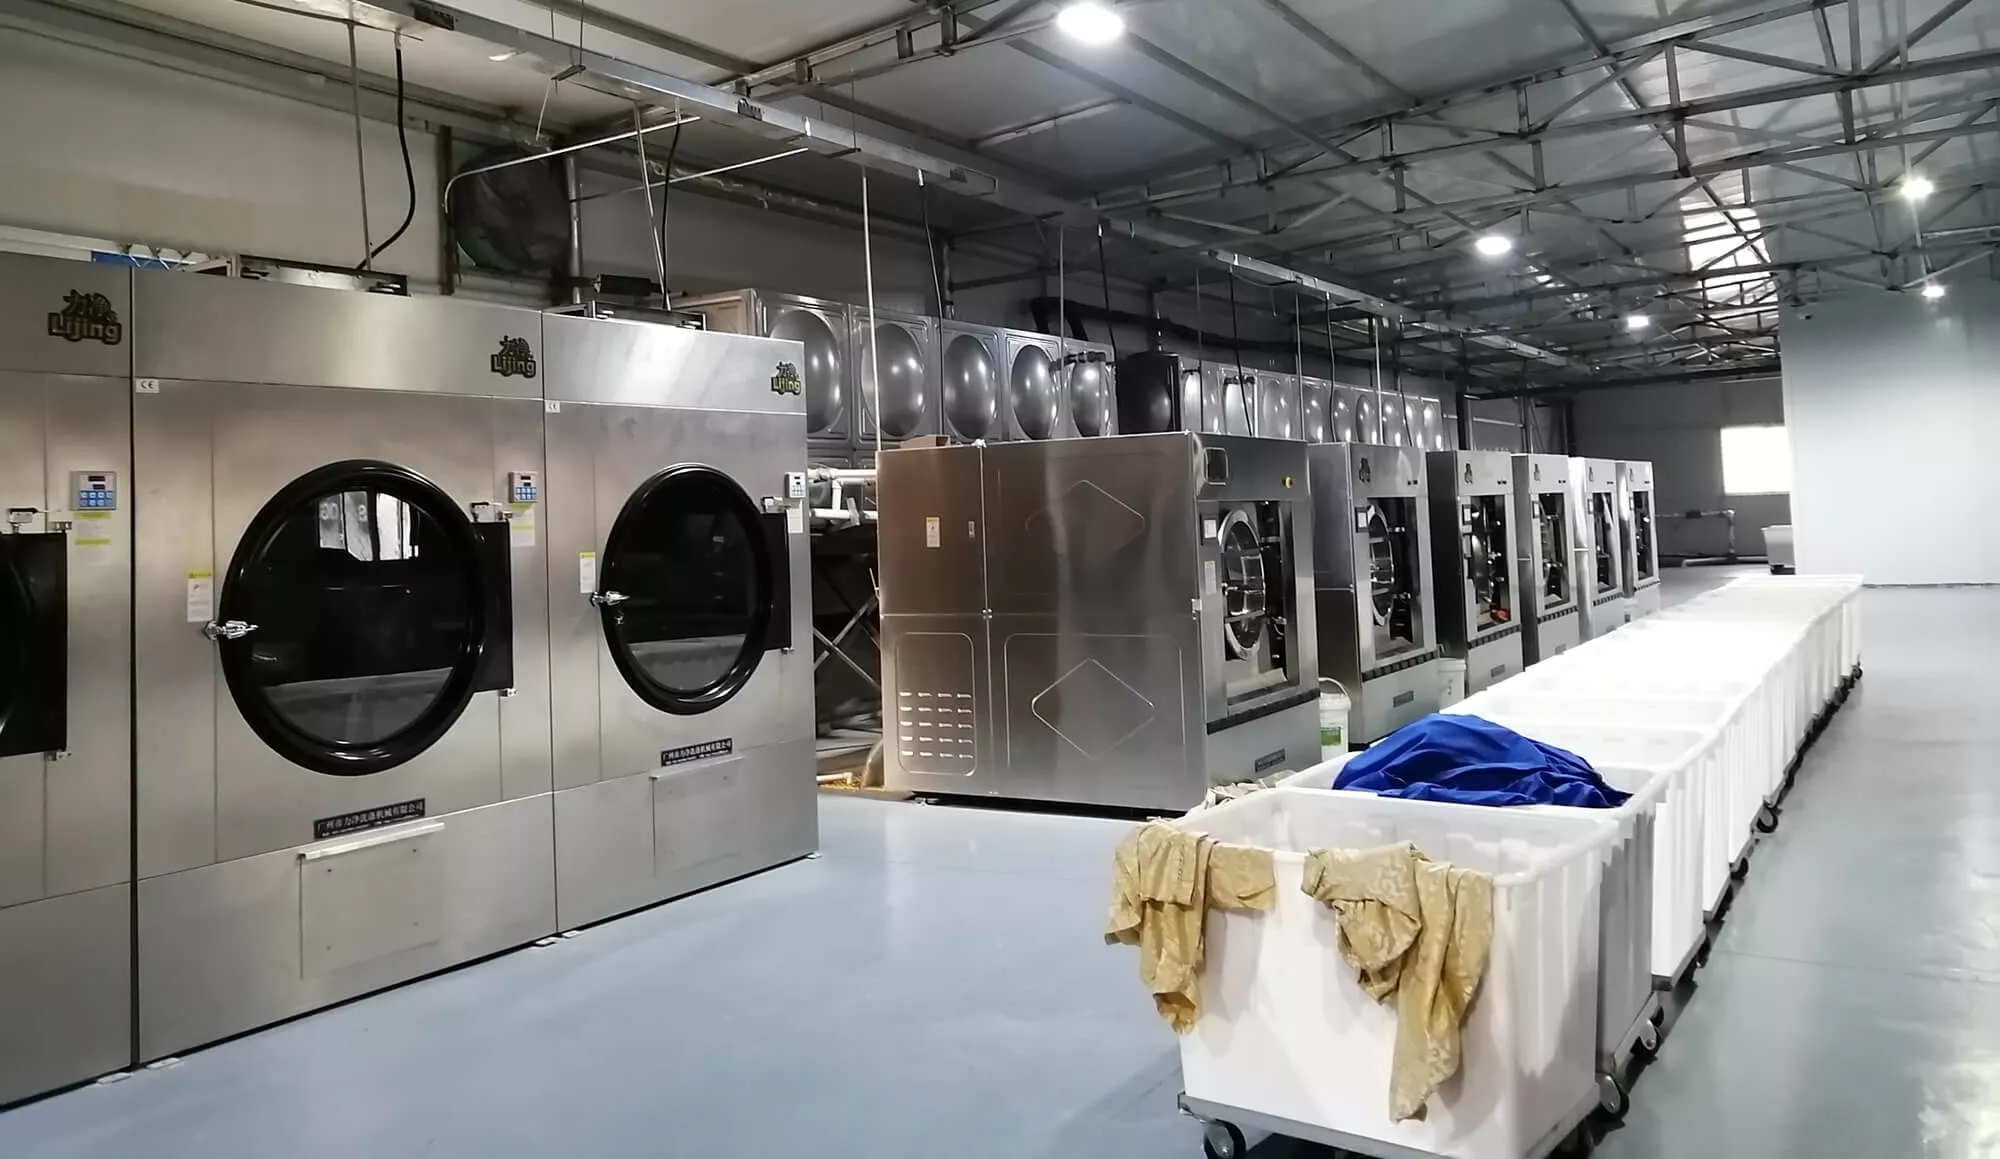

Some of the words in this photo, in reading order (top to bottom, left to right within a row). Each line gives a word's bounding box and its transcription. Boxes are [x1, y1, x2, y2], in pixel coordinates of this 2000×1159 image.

[48, 312, 122, 345] Lijing
[491, 354, 536, 378] Lijing
[771, 377, 801, 395] Lijing
